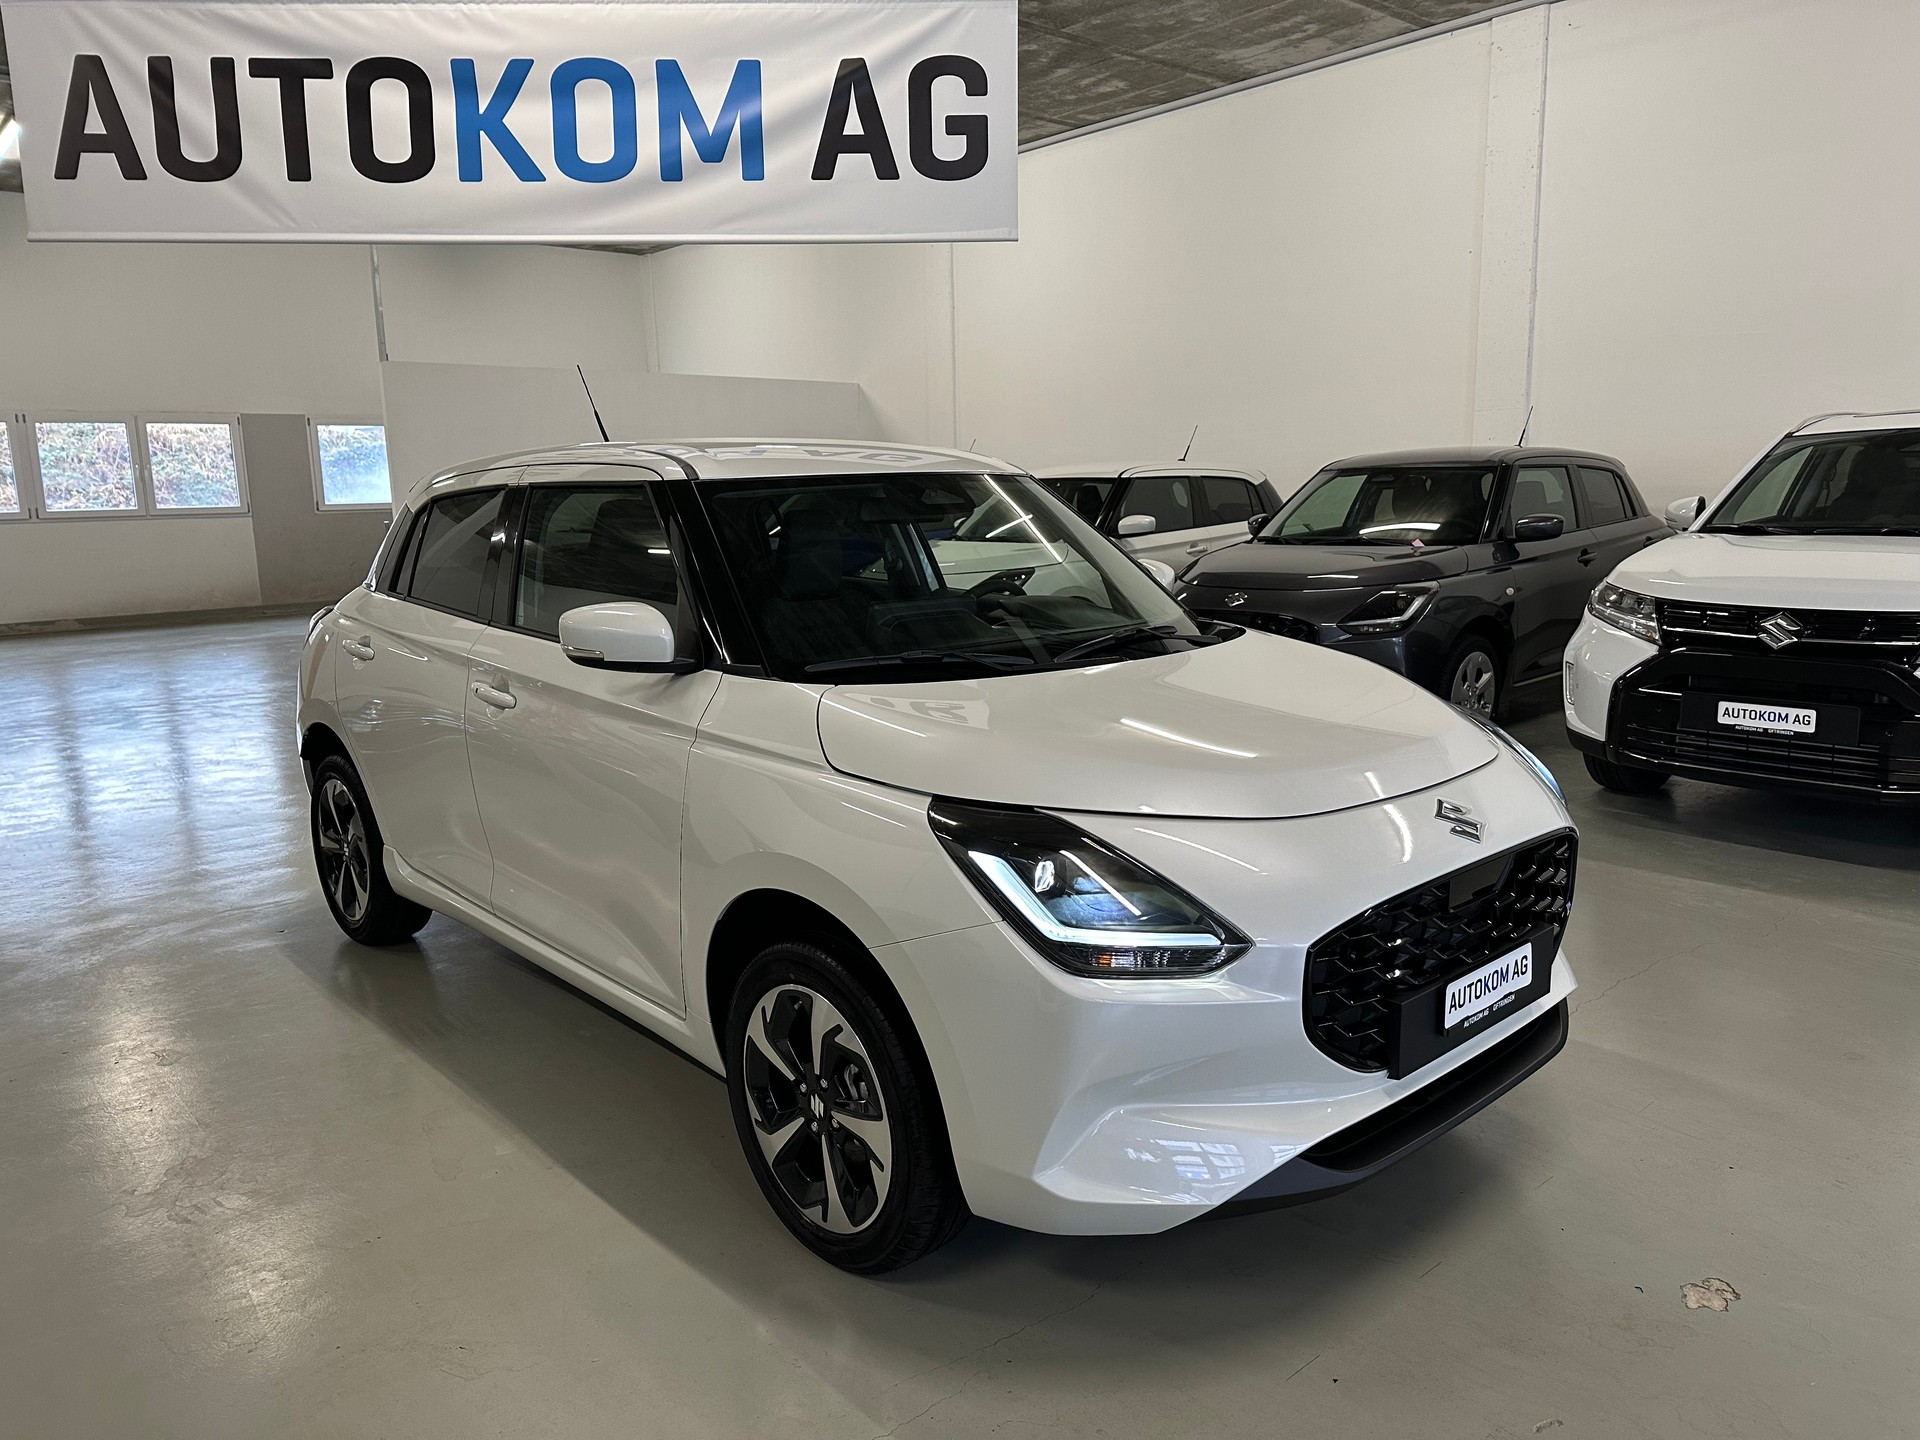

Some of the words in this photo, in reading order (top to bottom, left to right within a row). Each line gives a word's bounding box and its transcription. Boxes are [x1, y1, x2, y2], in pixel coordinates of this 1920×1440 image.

[54, 54, 764, 183] AUTOKOM
[811, 54, 989, 182] AG
[1722, 706, 1789, 724] AUTOKOM
[1792, 713, 1811, 726] AG
[1448, 963, 1510, 1014] AUTOKOM
[1511, 954, 1528, 980] AG
[1463, 1011, 1482, 1028] AUTOKOM
[1482, 1007, 1490, 1017] AG
